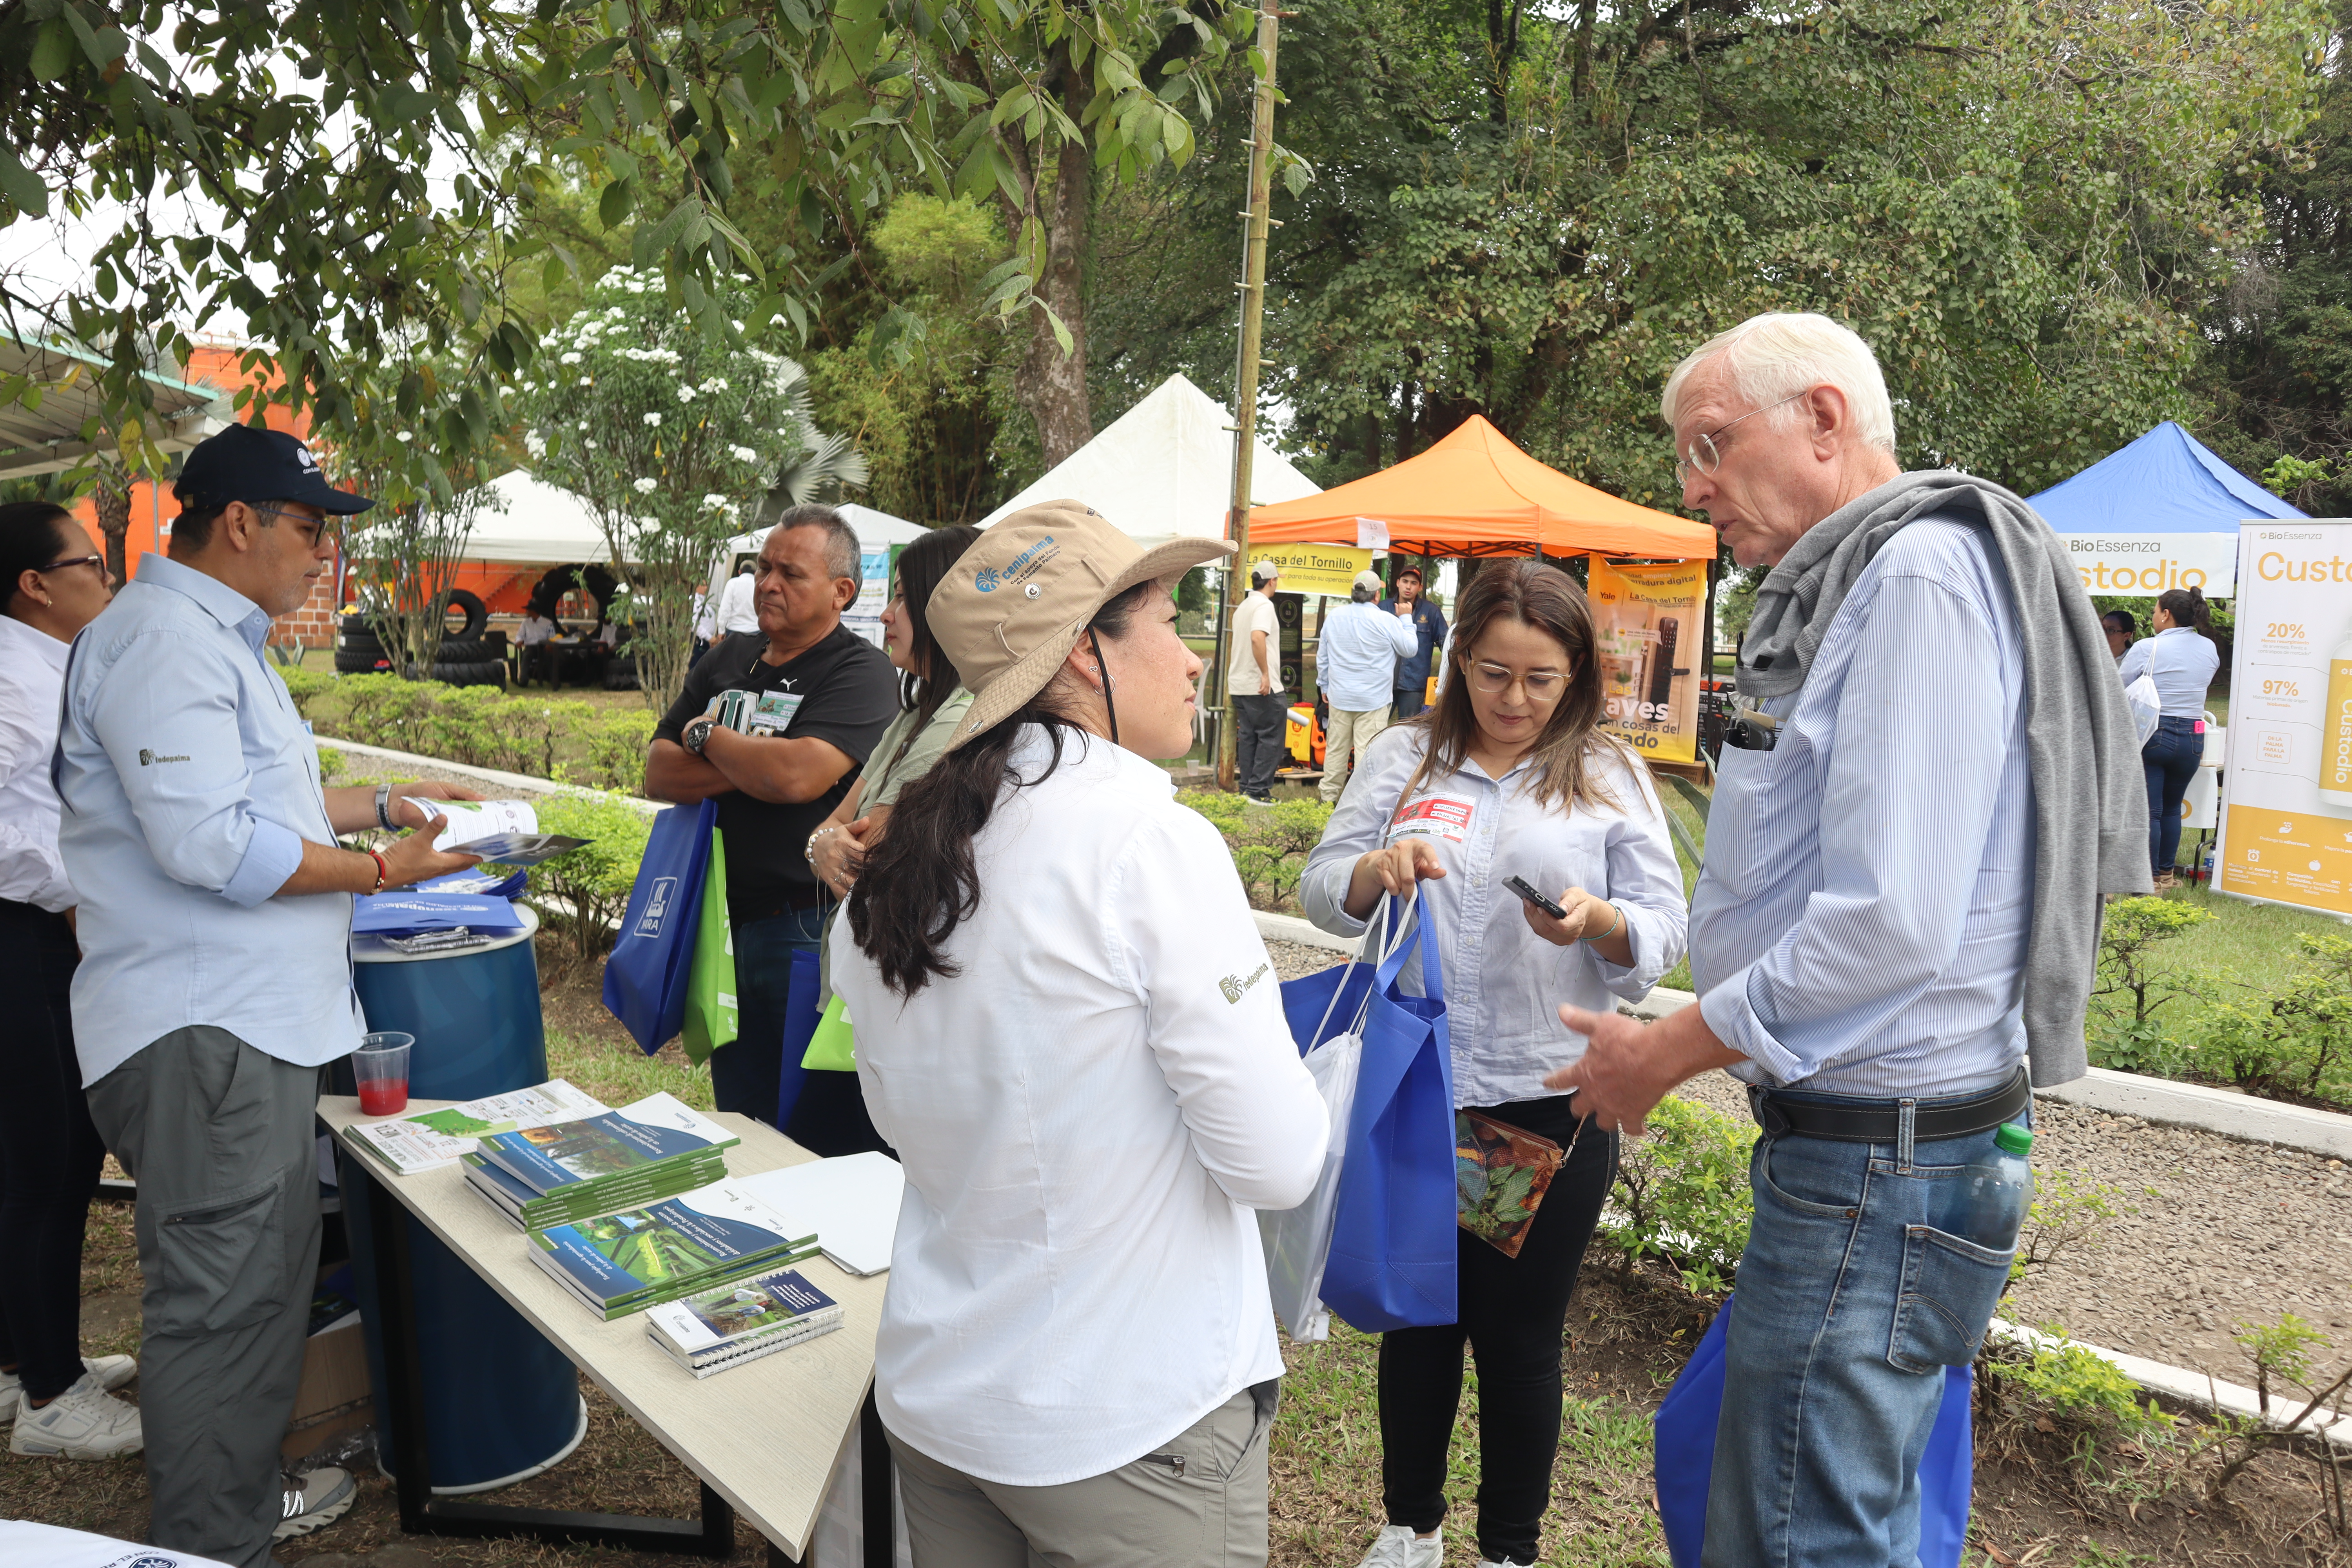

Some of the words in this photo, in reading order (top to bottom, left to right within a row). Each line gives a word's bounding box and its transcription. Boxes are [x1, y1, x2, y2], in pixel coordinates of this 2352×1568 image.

[1002, 535, 1054, 580] cenipalma
[1010, 576, 1020, 585] Con
[1023, 560, 1039, 574] apoyo
[1045, 543, 1060, 556] Fondo
[1022, 563, 1043, 581] Fomento
[1041, 548, 1060, 565] Palmero
[1247, 554, 1258, 563] La
[1261, 554, 1287, 564] Casa
[1290, 555, 1306, 565] del
[1311, 556, 1352, 569] Tornillo
[2258, 551, 2352, 582] Cust
[1667, 574, 1696, 585] digital
[2267, 623, 2305, 639] 20%
[1609, 682, 1632, 695] Las
[2263, 680, 2298, 696] 97%
[1622, 720, 1658, 732] cosas
[1662, 723, 1680, 734] del
[2335, 699, 2352, 783] Custodio
[155, 754, 191, 763] fedepalma
[2227, 877, 2258, 885] reaplicaciones.
[2287, 876, 2312, 884] herbicidas,
[2313, 881, 2340, 889] insecticidas,
[2287, 881, 2308, 889] fungicidas
[2314, 885, 2339, 894] fertilizantes
[1243, 963, 1269, 991] fedepalma
[372, 1124, 403, 1138] META
[598, 1118, 629, 1134] enfermedades
[633, 1132, 653, 1140] palma
[629, 1135, 664, 1154] Reconocimiento
[655, 1211, 674, 1222] insectos
[674, 1224, 694, 1234] manejo
[691, 1226, 715, 1239] asociados
[559, 1240, 586, 1258] agroindustria
[579, 1245, 594, 1254] aceite
[691, 1235, 728, 1257] Reconocimiento
[712, 1240, 742, 1256] defoliadores
[591, 1255, 608, 1265] palma
[757, 1263, 779, 1272] Reconocimiento
